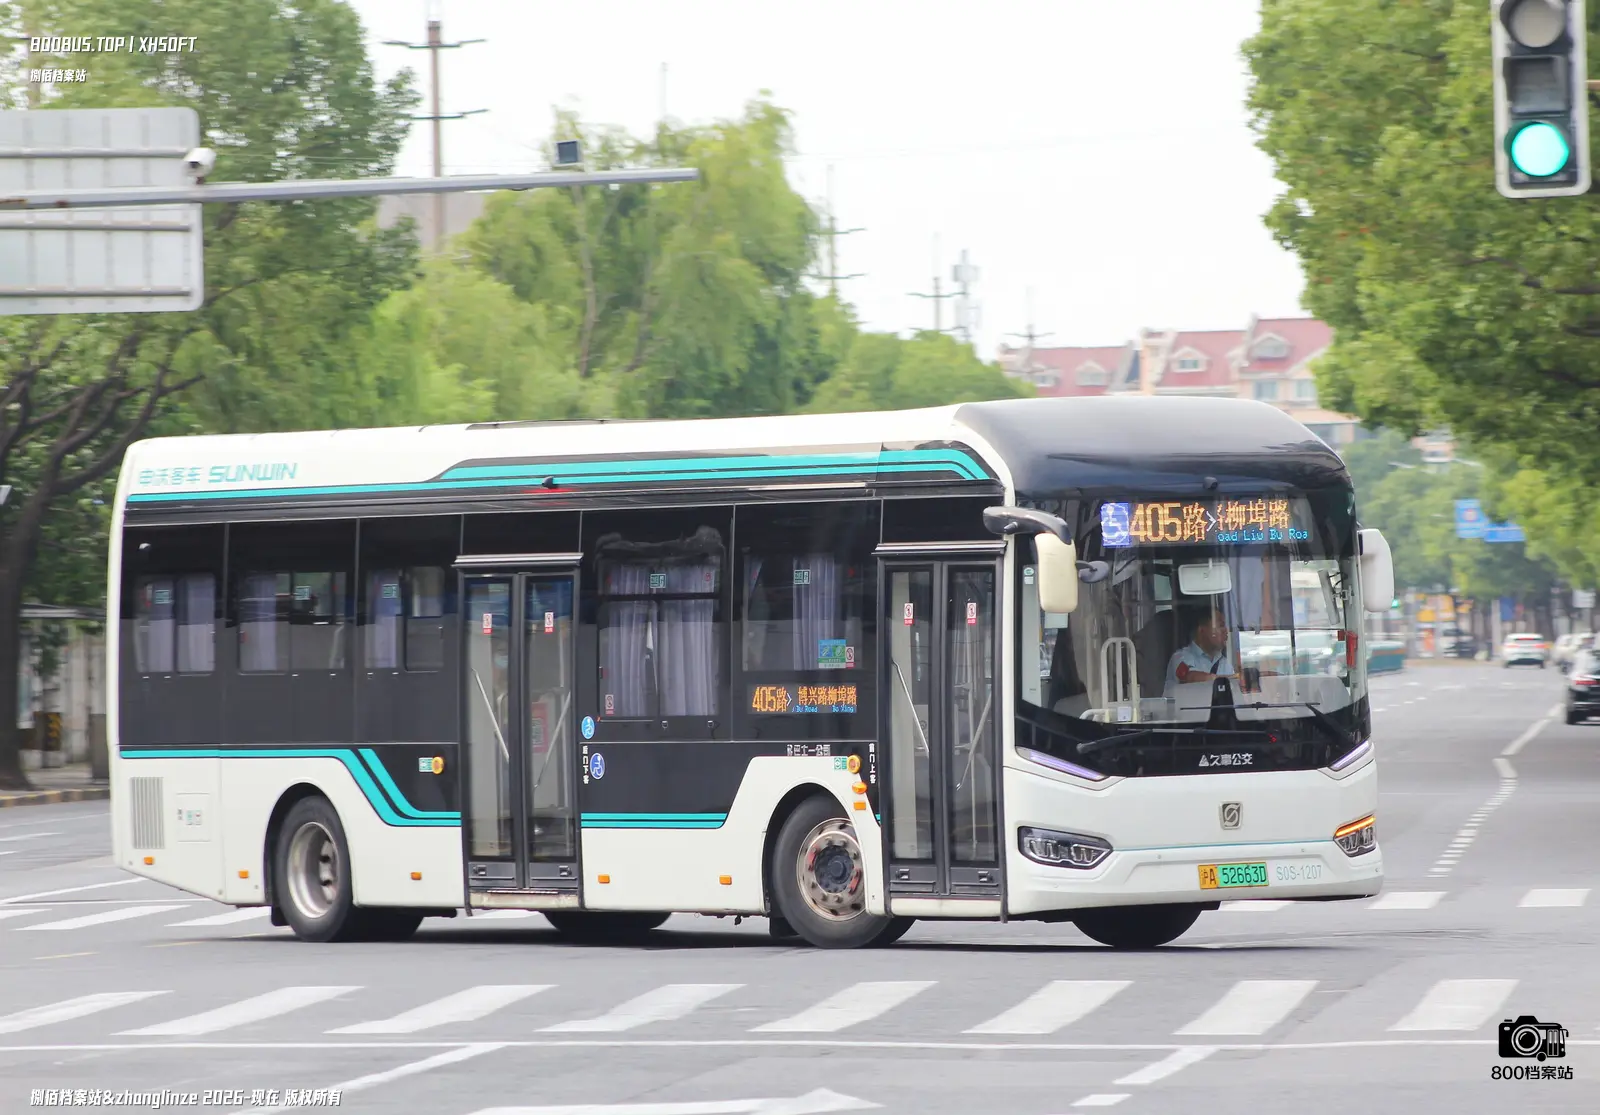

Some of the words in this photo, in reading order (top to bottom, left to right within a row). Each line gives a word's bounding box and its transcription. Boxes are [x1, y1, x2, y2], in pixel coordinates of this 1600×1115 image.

[208, 463, 298, 483] SUNWIN
[1129, 502, 1207, 543] 405路
[752, 686, 787, 712] 405路
